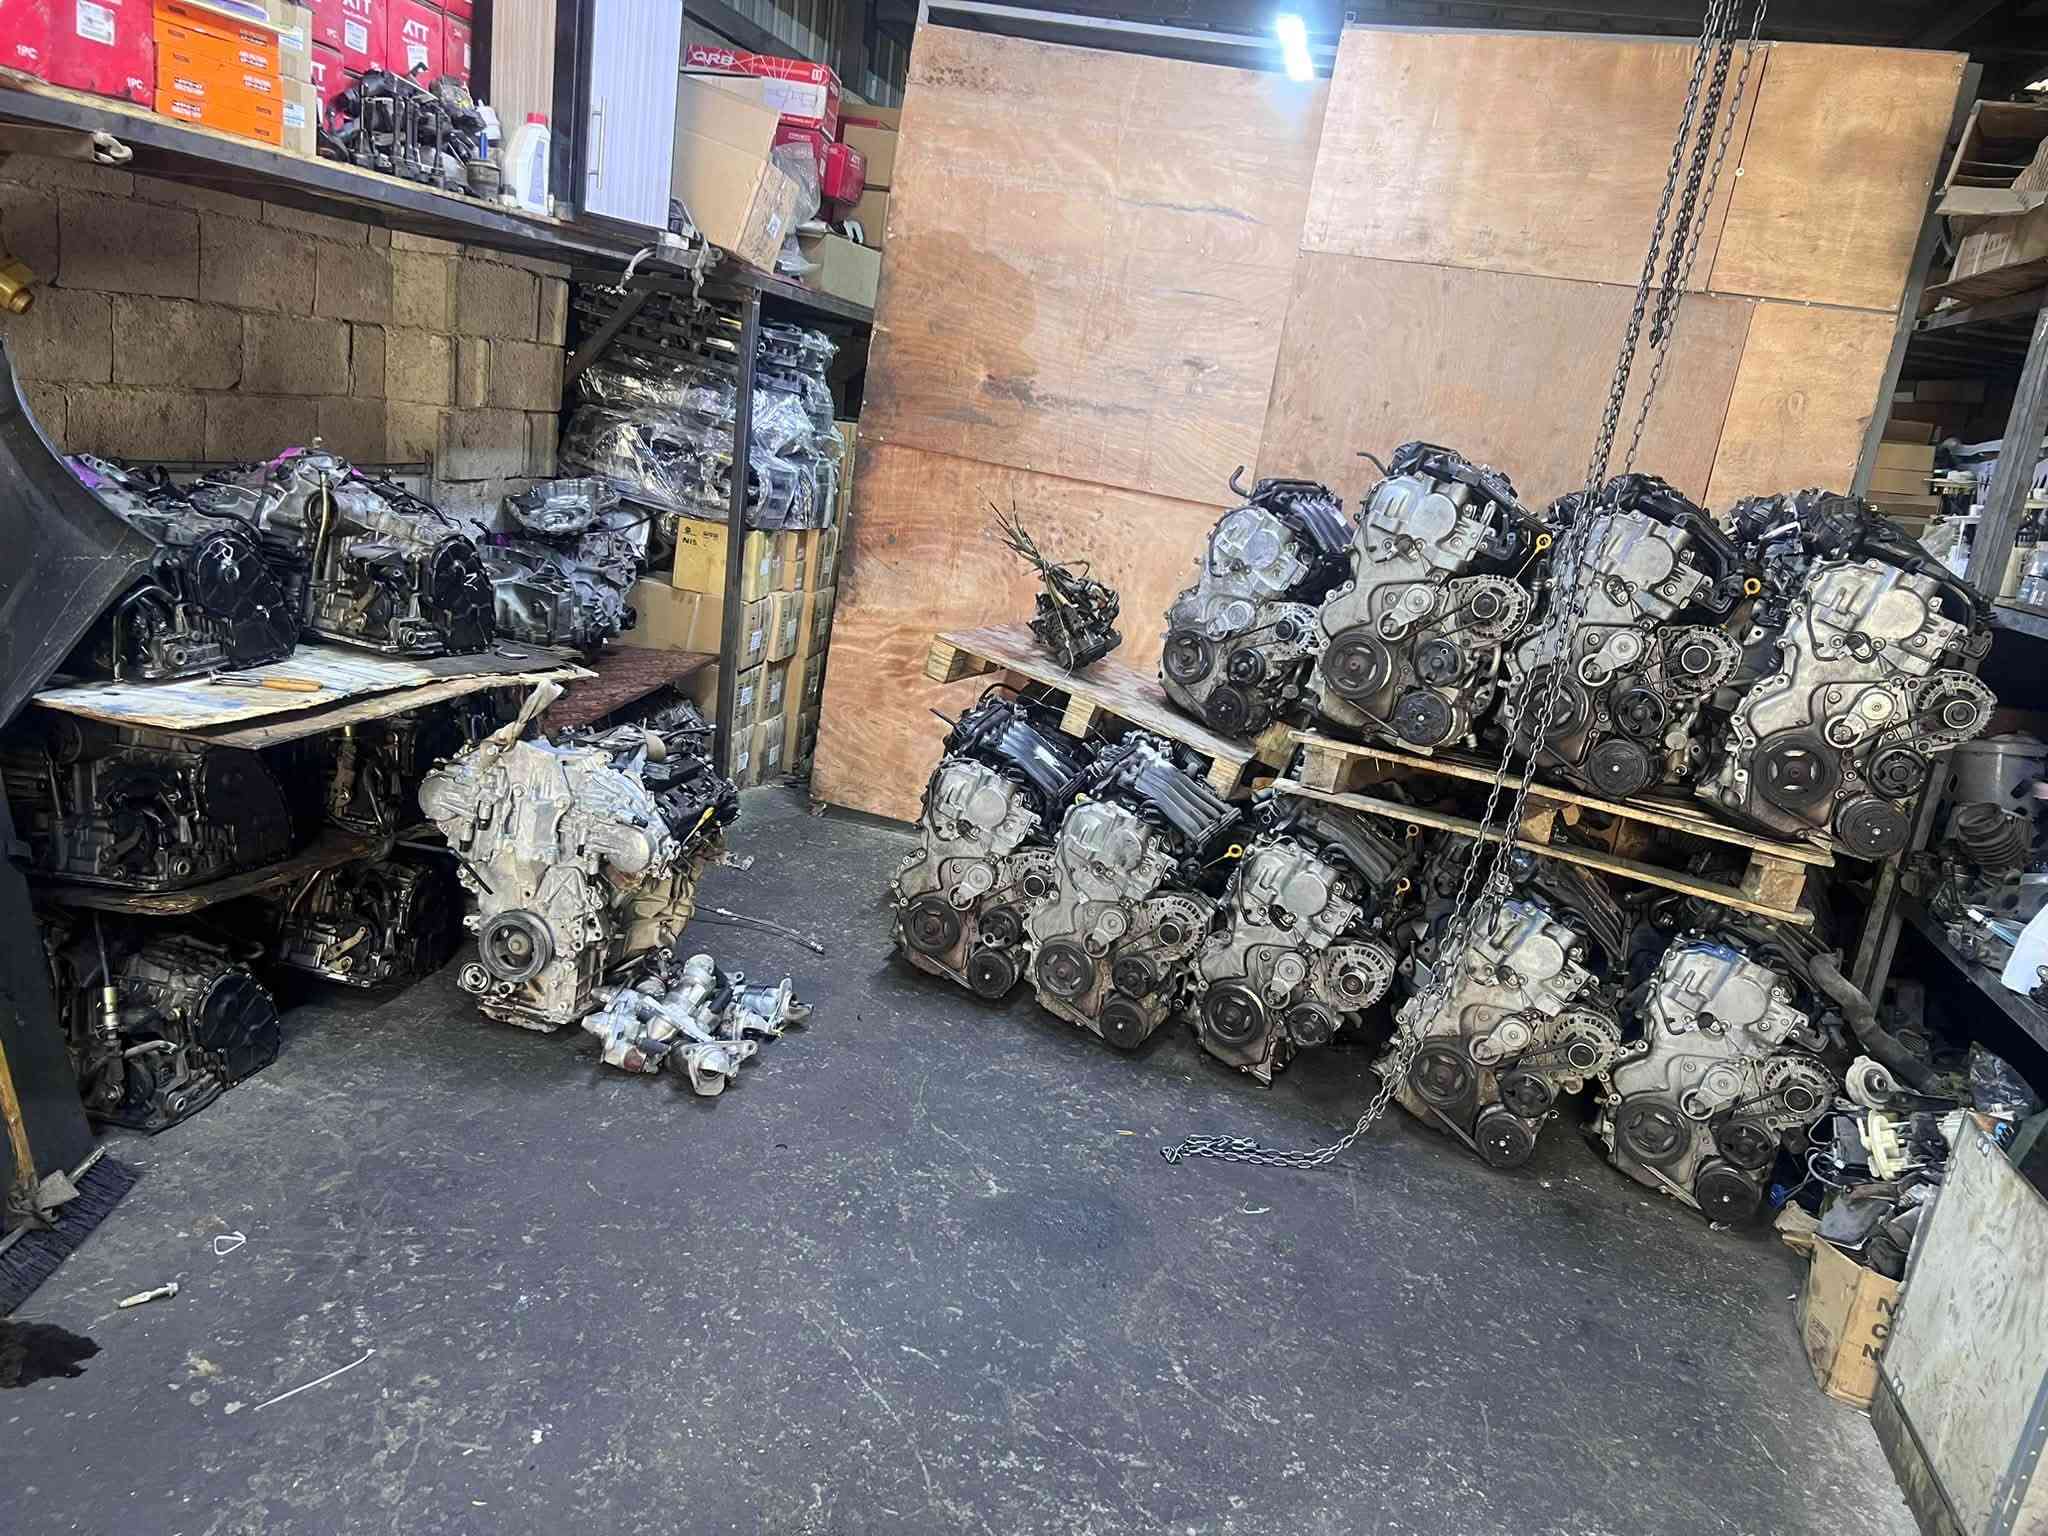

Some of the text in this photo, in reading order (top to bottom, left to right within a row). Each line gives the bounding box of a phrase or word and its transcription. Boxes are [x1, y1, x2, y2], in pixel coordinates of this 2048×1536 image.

[402, 19, 429, 42] ATT
[16, 44, 39, 60] 1PC
[126, 76, 145, 91] 1PC
